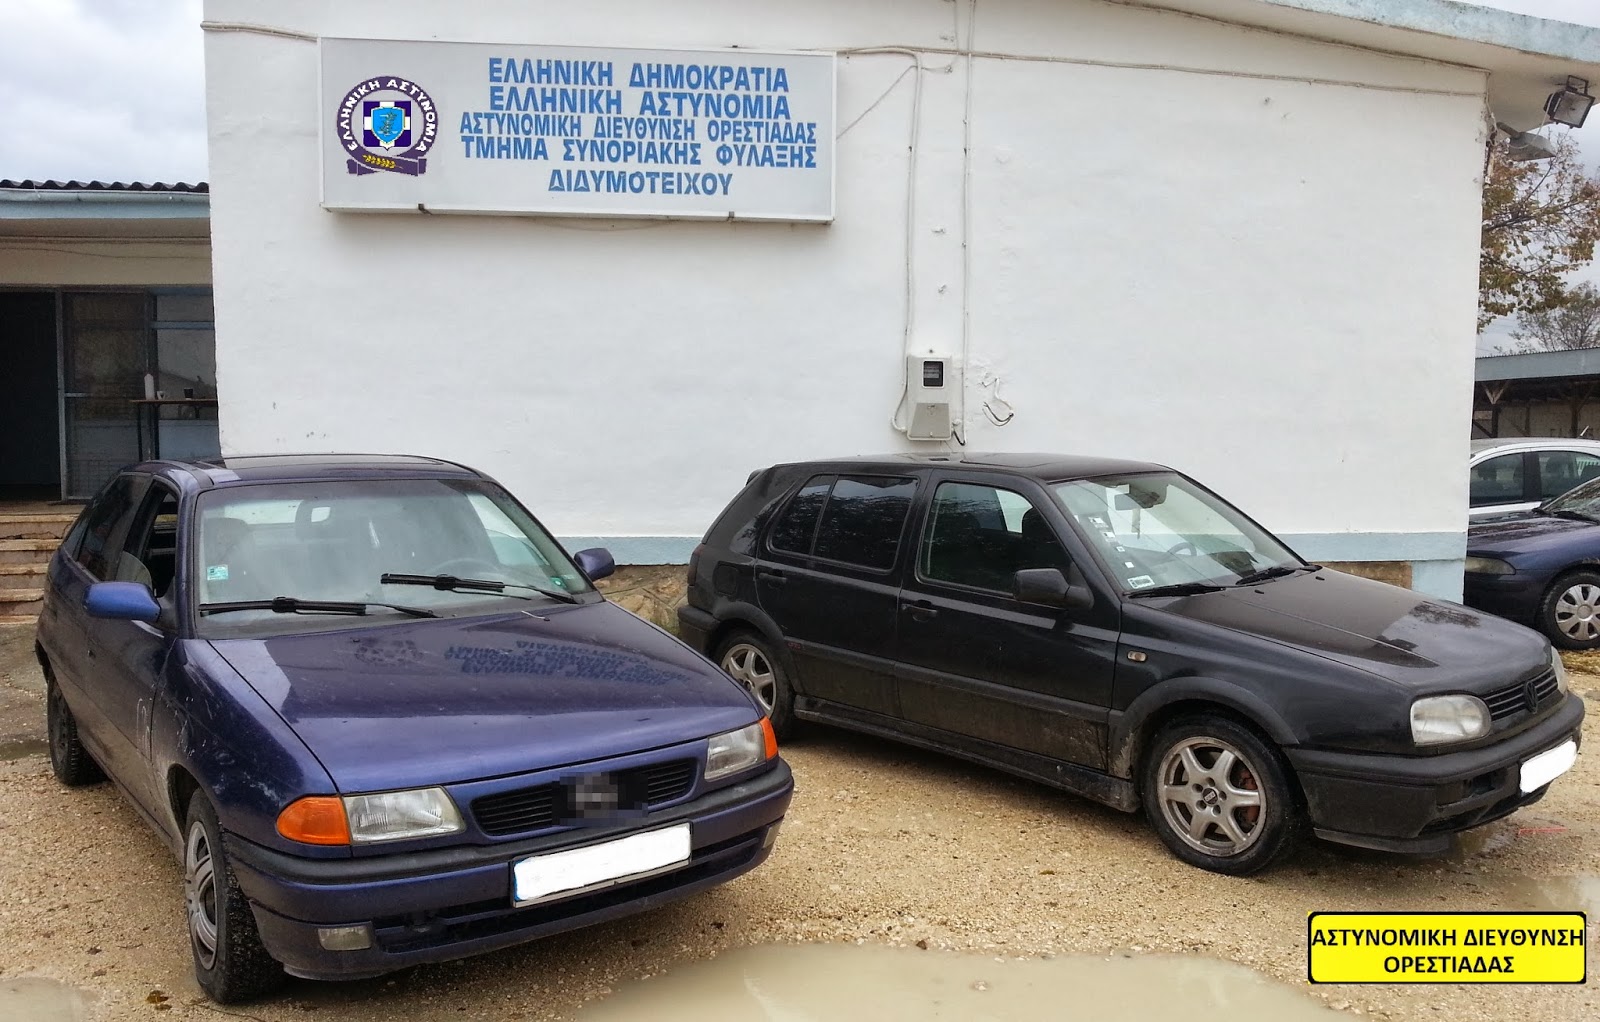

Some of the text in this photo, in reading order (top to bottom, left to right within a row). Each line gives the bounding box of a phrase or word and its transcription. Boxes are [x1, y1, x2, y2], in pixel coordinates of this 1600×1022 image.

[489, 57, 789, 92] ΕΛΛΗΝΙΚΗ ΔΗΜΟΚΡΑΤΙΑ
[341, 79, 436, 151] ΕΛΛΗΝΙΚΗ ΑΣΤΥΝΟΜΙΑ
[490, 86, 791, 120] ΕΛΛΗΝΙΚΗ ΑΣΤΥΝΟΜΙΑ
[460, 112, 817, 145] ΑΣΤΥΝΟΜΙΚΗ ΔΙΕΥΘΥΝΣΗ ΟΡΕΣΤΙΑΔΑΣ
[461, 135, 817, 168] ΤΜΗΜΑ ΣΥΝΟΡΙΑΚΗΣ ΦΥΛΑΞΗΣ
[548, 169, 733, 195] ΔΙΔΥΜΟΤΕΙΧΟΥ
